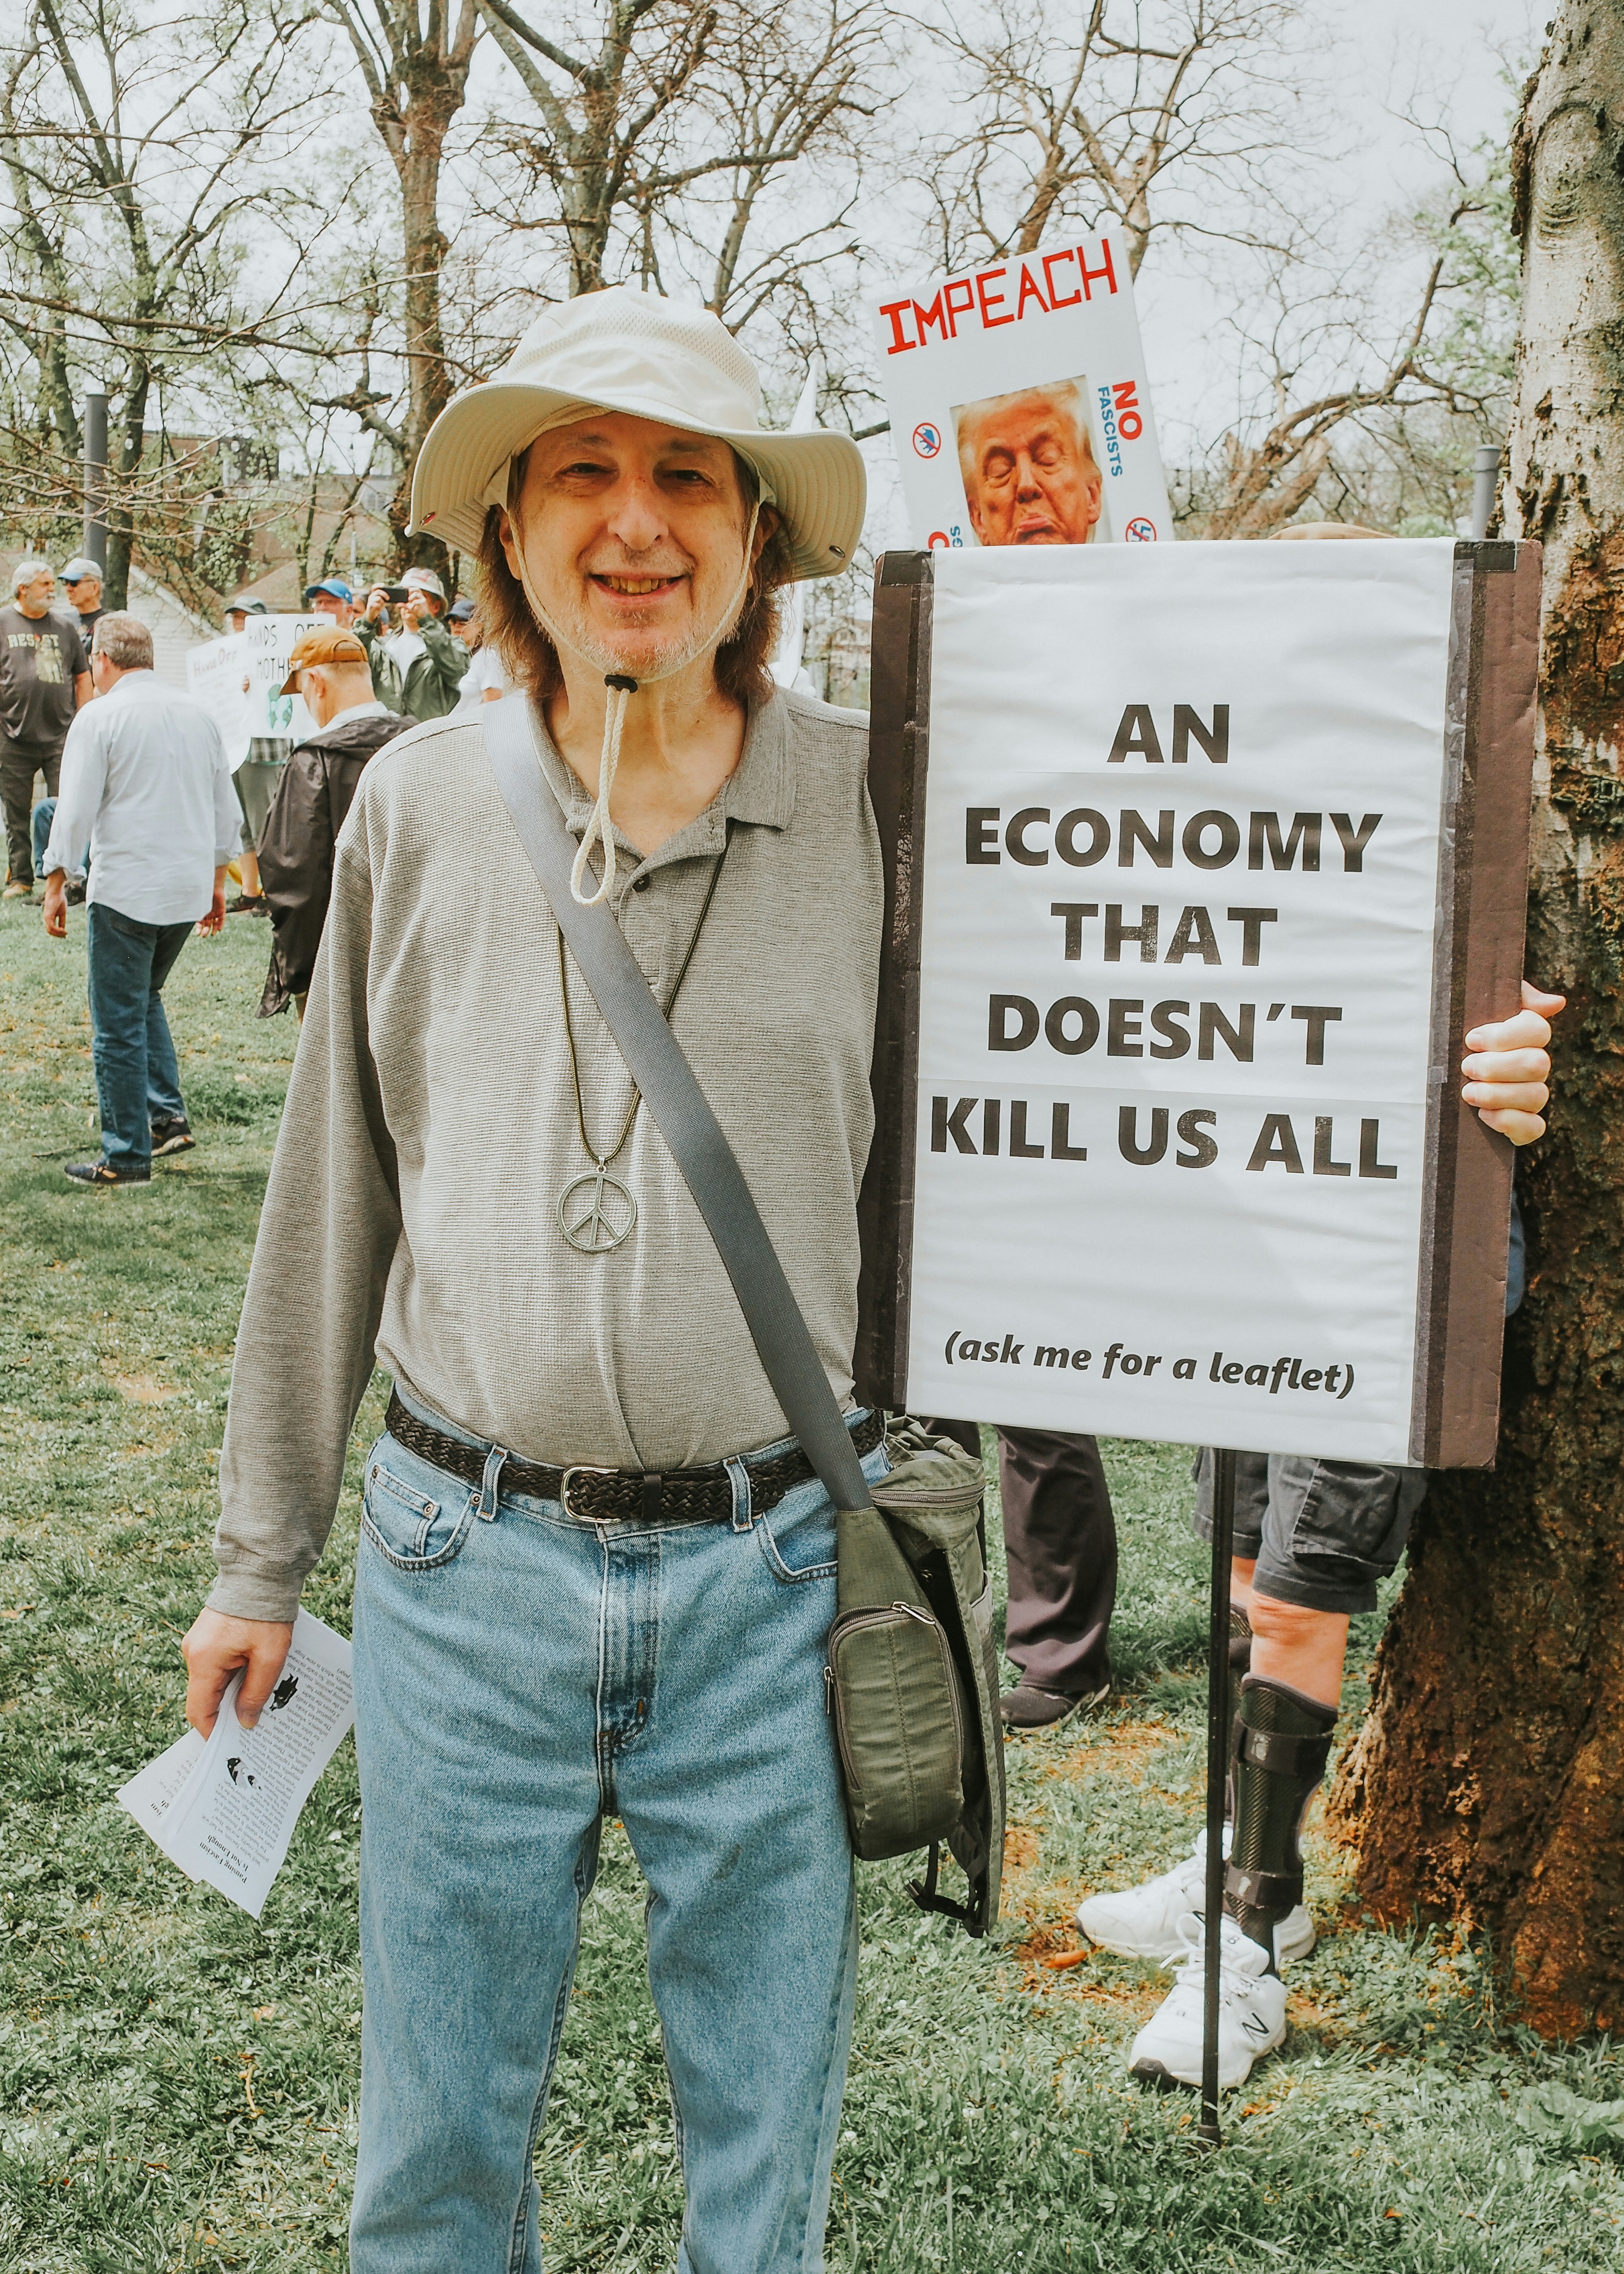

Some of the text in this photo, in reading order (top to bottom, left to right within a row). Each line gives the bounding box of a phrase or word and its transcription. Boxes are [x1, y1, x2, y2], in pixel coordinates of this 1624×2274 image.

[879, 238, 1118, 355] IMPEACH
[1097, 386, 1123, 477] FASCISTS
[1111, 380, 1143, 440] NO
[1107, 704, 1229, 763] AN
[965, 807, 1384, 873] ECONOMY
[1050, 903, 1278, 966] THAT
[987, 994, 1342, 1065] DOESN'T
[930, 1096, 1398, 1179] KILL US ALL
[944, 1330, 1356, 1399] (ask me for a leaflet)
[198, 1842, 249, 1883] Pausing Fascism
[206, 1833, 249, 1871] Is Not Enough
